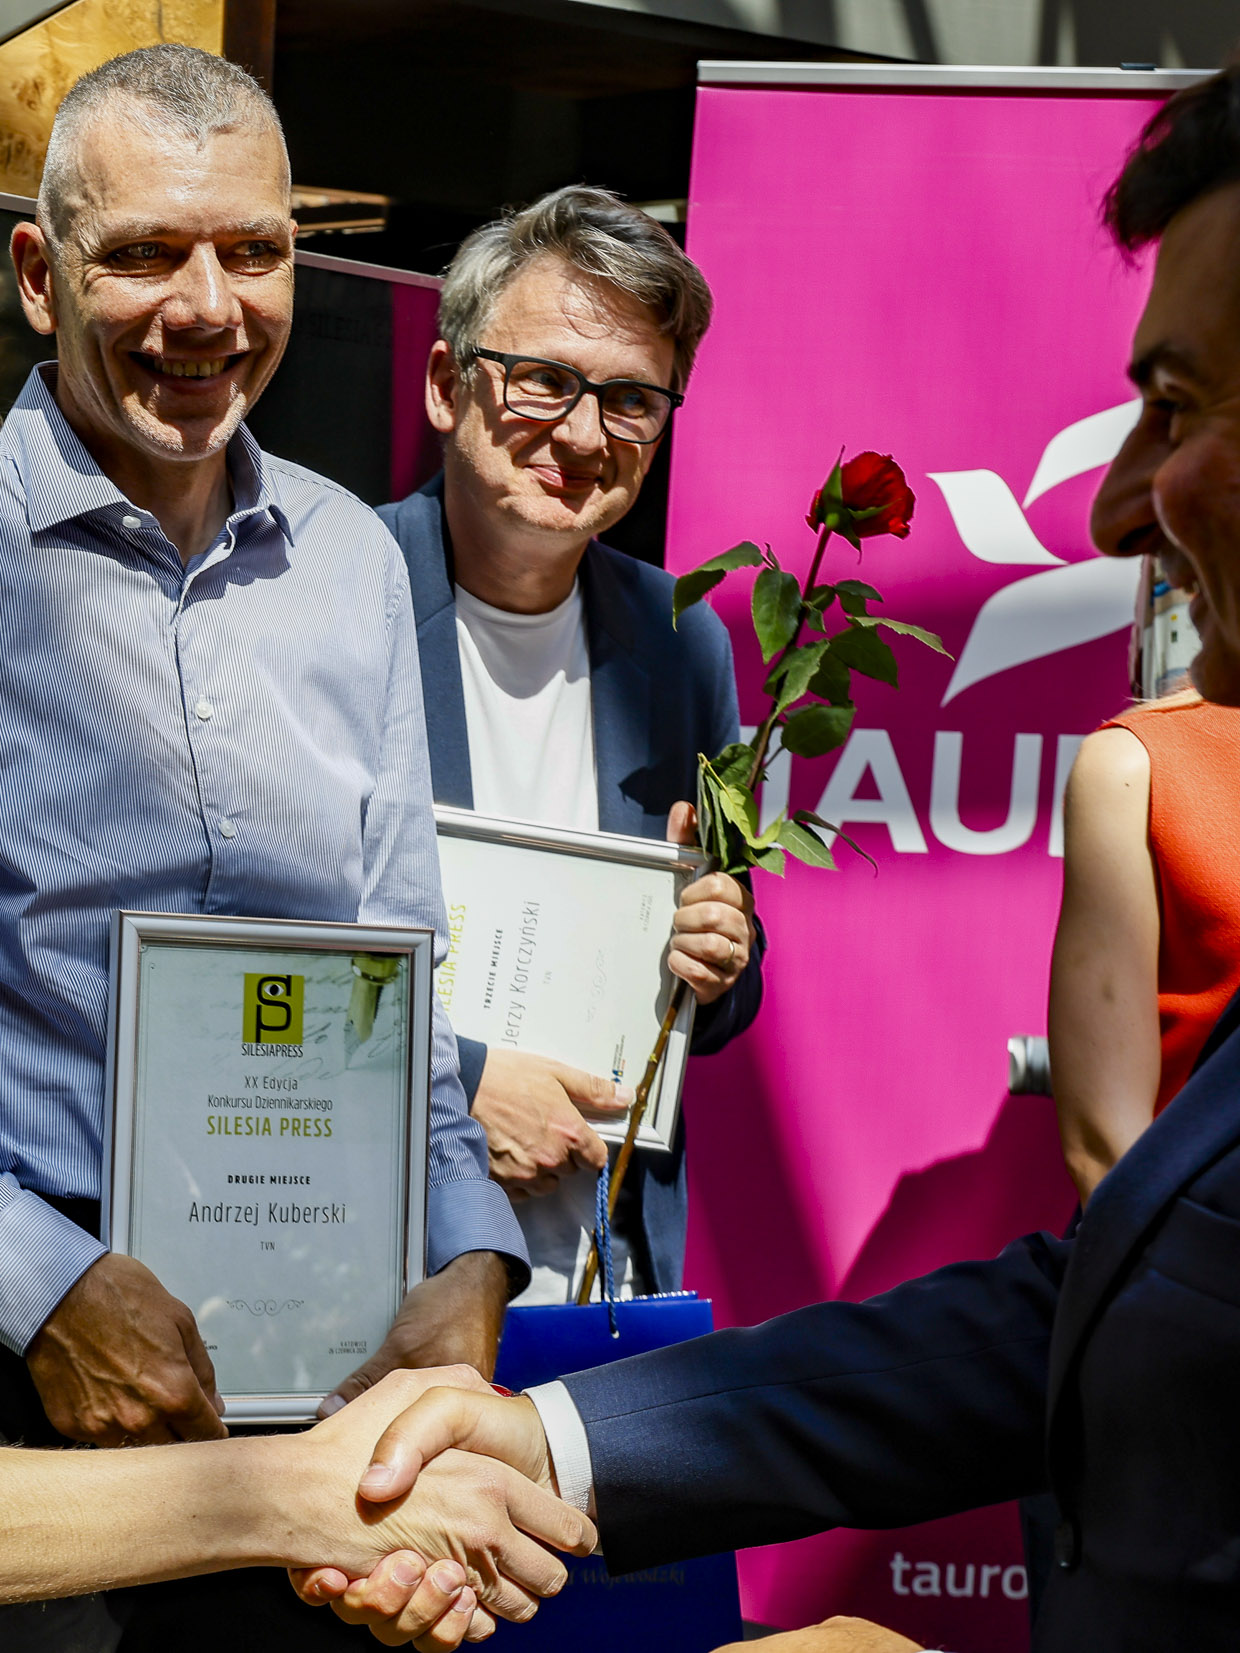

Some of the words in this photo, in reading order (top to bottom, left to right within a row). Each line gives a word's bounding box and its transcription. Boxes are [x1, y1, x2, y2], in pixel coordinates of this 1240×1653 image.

[510, 900, 540, 994] Korczyński
[437, 961, 457, 1012] LESIA
[501, 1000, 526, 1046] Jerzy
[241, 1043, 303, 1058] SILESIAPRESS
[244, 1076, 258, 1088] XX
[263, 1076, 298, 1091] Edycja
[208, 1095, 252, 1109] Konkursu
[255, 1096, 333, 1112] Dziennikarskiego
[206, 1115, 272, 1136] SILESIA
[280, 1117, 333, 1138] PRESS
[227, 1174, 265, 1185] DRUGIE
[270, 1175, 311, 1185] MIEJSCE
[189, 1201, 259, 1226] Andrzej
[268, 1202, 346, 1224] Kuberski
[260, 1241, 275, 1251] TVN
[890, 1552, 1029, 1599] tauro
